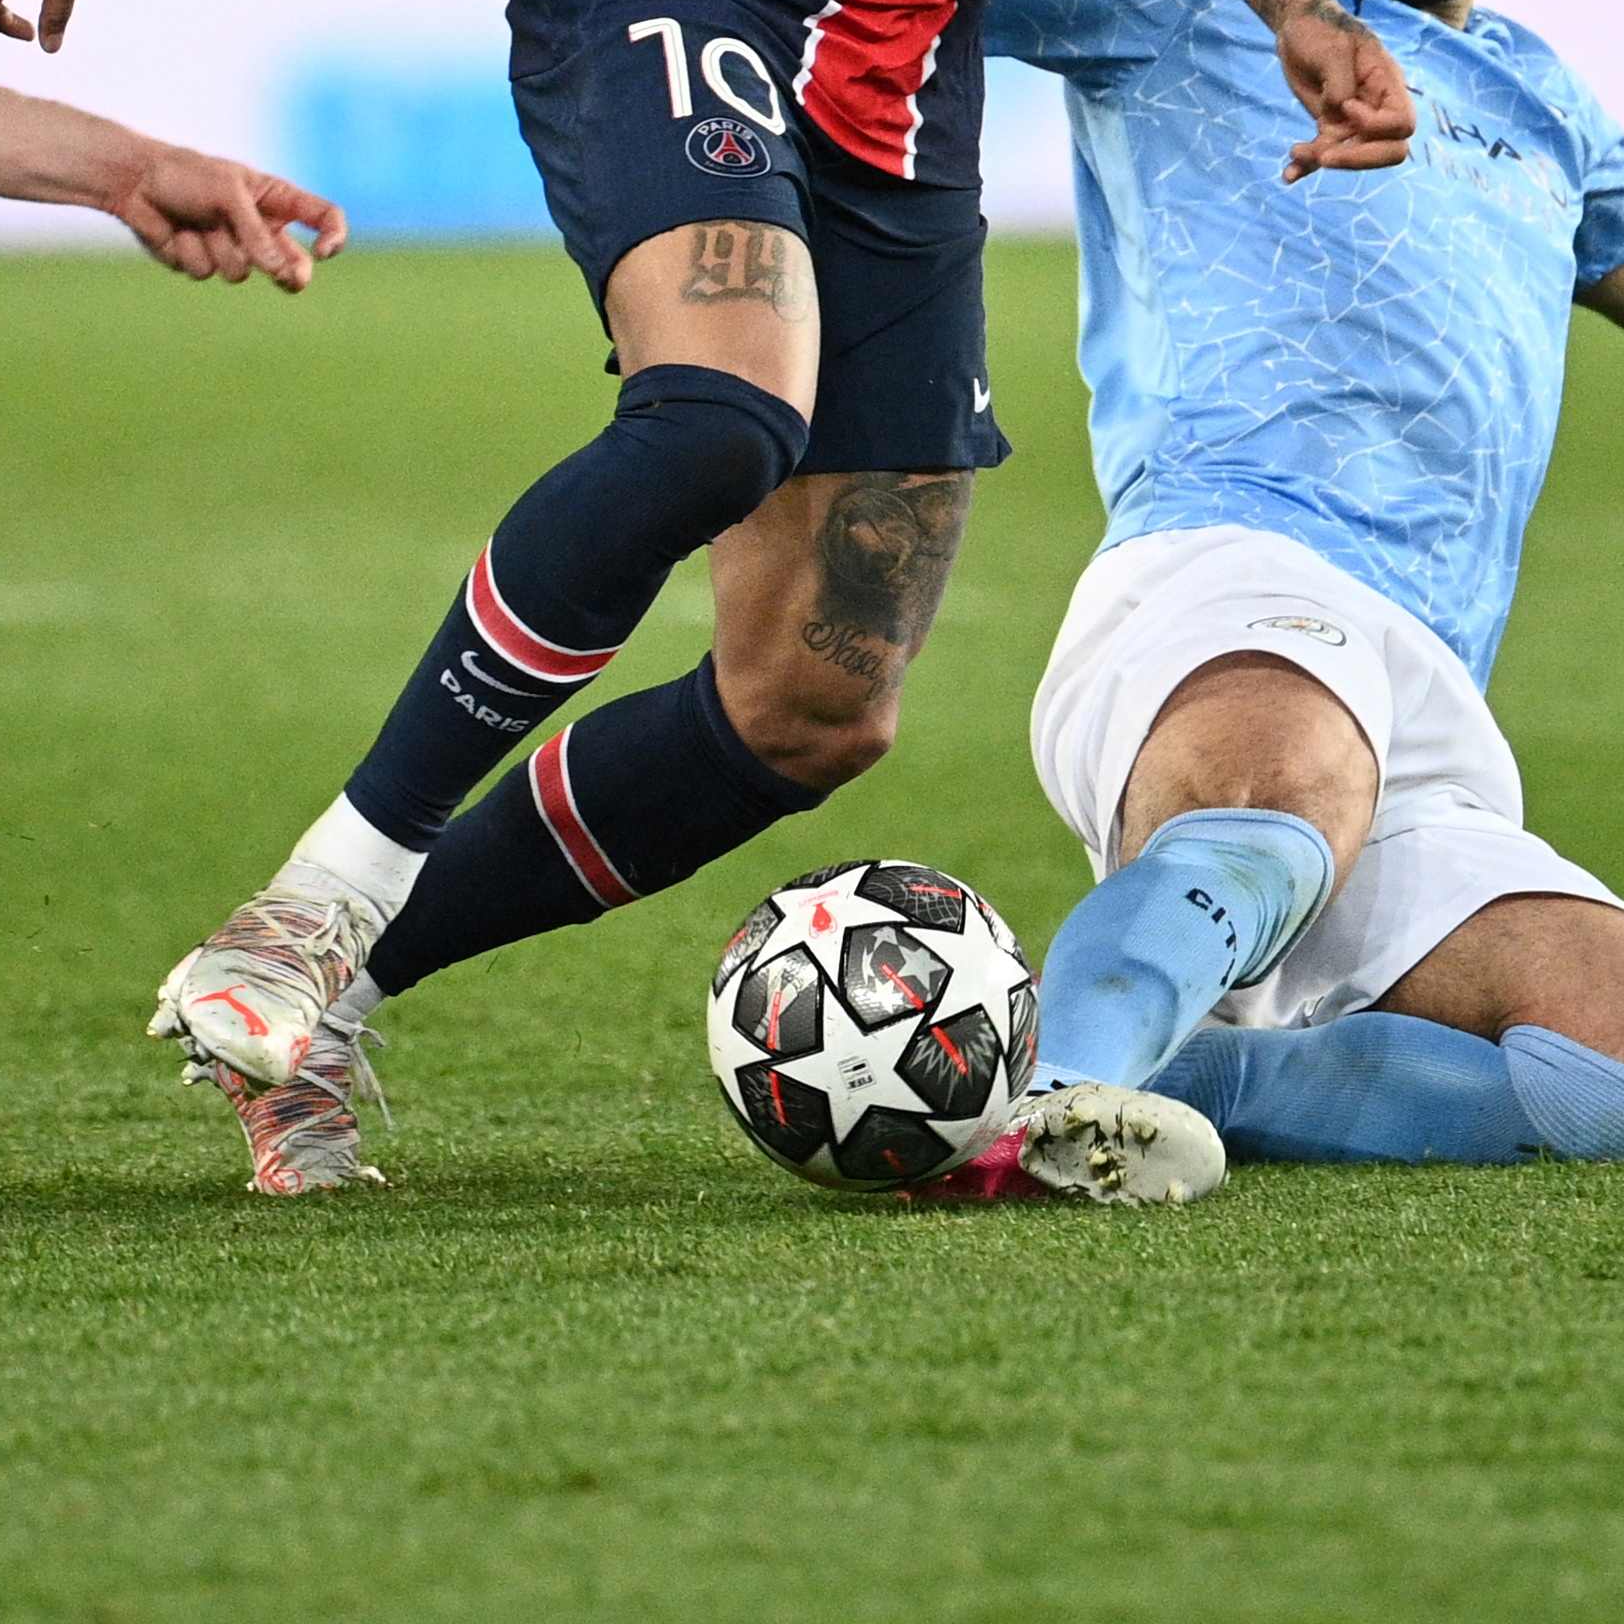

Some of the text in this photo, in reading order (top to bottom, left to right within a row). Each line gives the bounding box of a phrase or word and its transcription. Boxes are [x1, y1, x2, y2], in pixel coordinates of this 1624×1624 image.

[628, 16, 786, 137] 10
[697, 120, 753, 141] PARIS
[440, 668, 530, 732] PARIS
